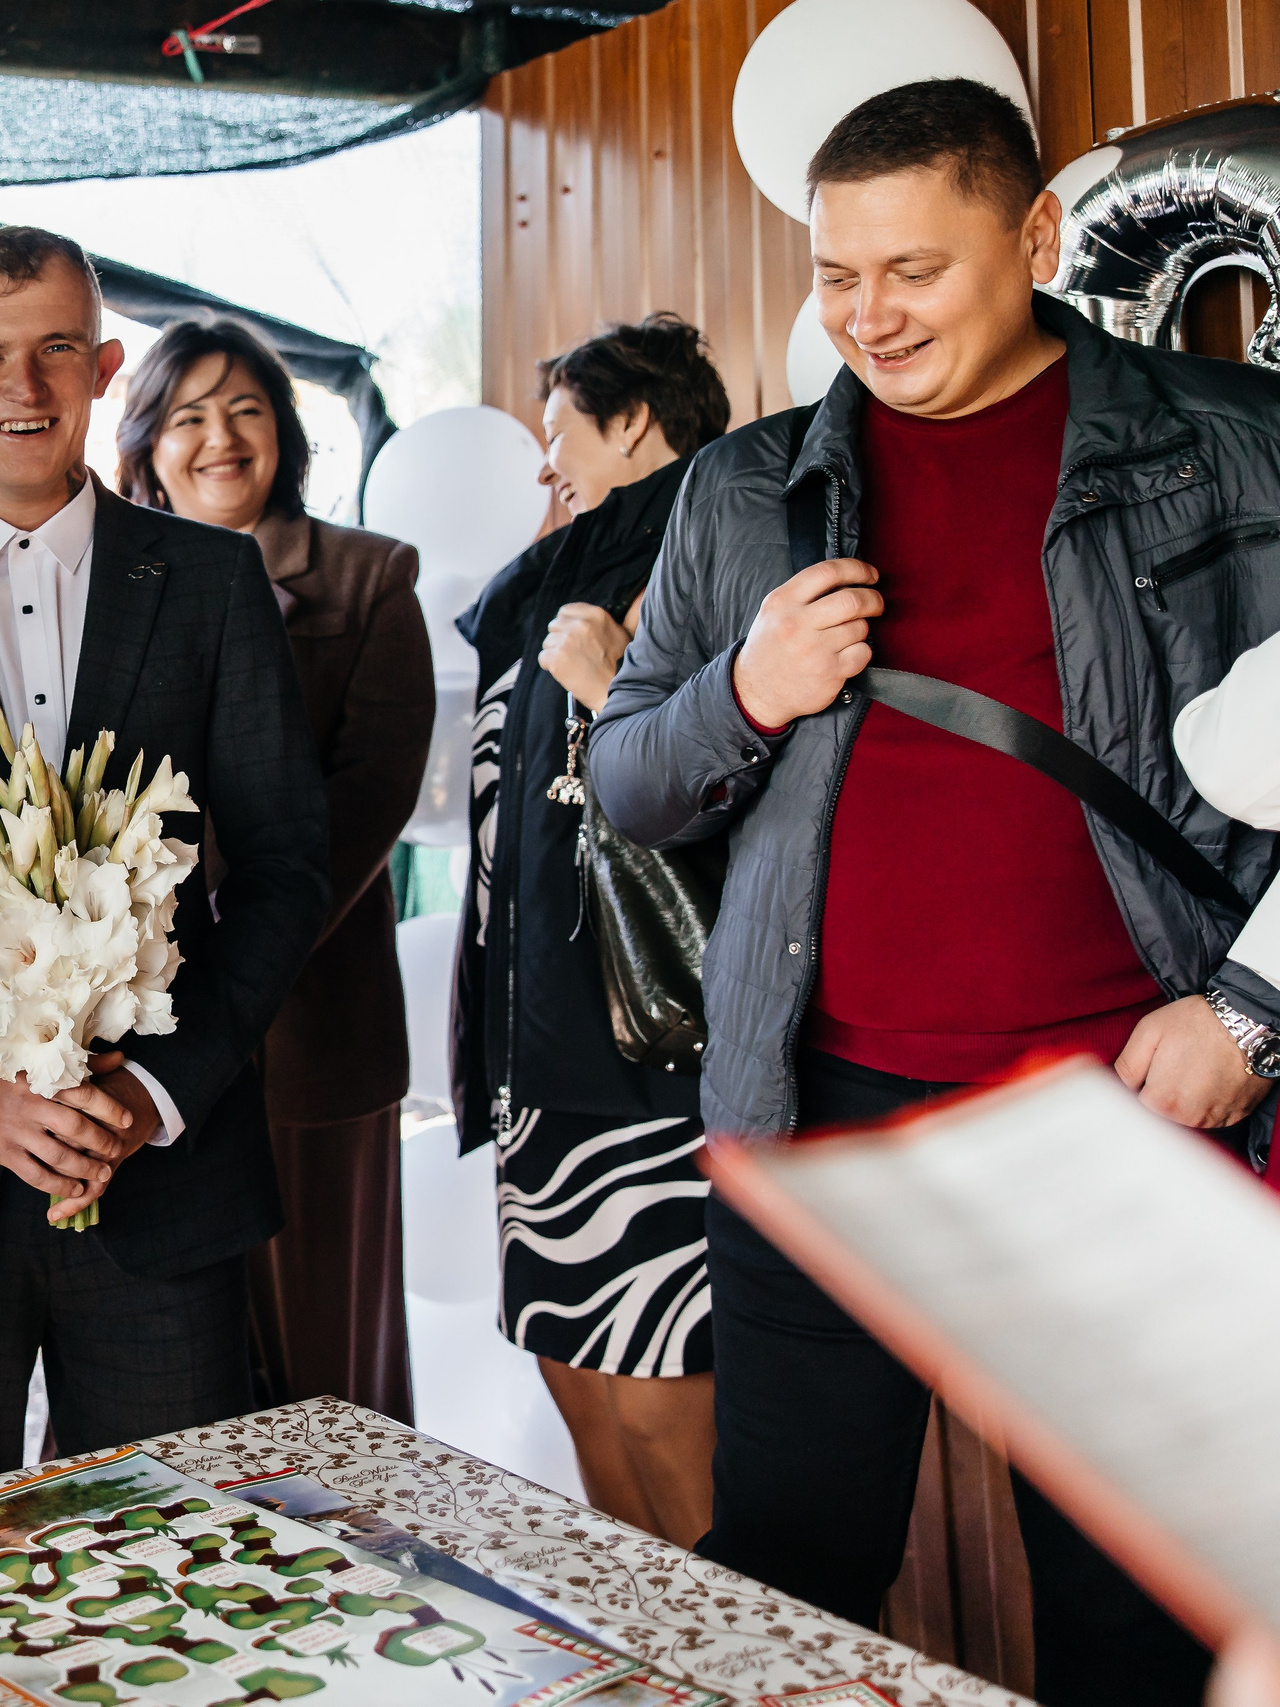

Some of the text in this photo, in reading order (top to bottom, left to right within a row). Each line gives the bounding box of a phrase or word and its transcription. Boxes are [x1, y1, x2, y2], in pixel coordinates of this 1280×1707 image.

[332, 1465, 400, 1485] Best Wishes
[349, 1477, 375, 1488] For
[523, 1546, 566, 1559] Wishes
